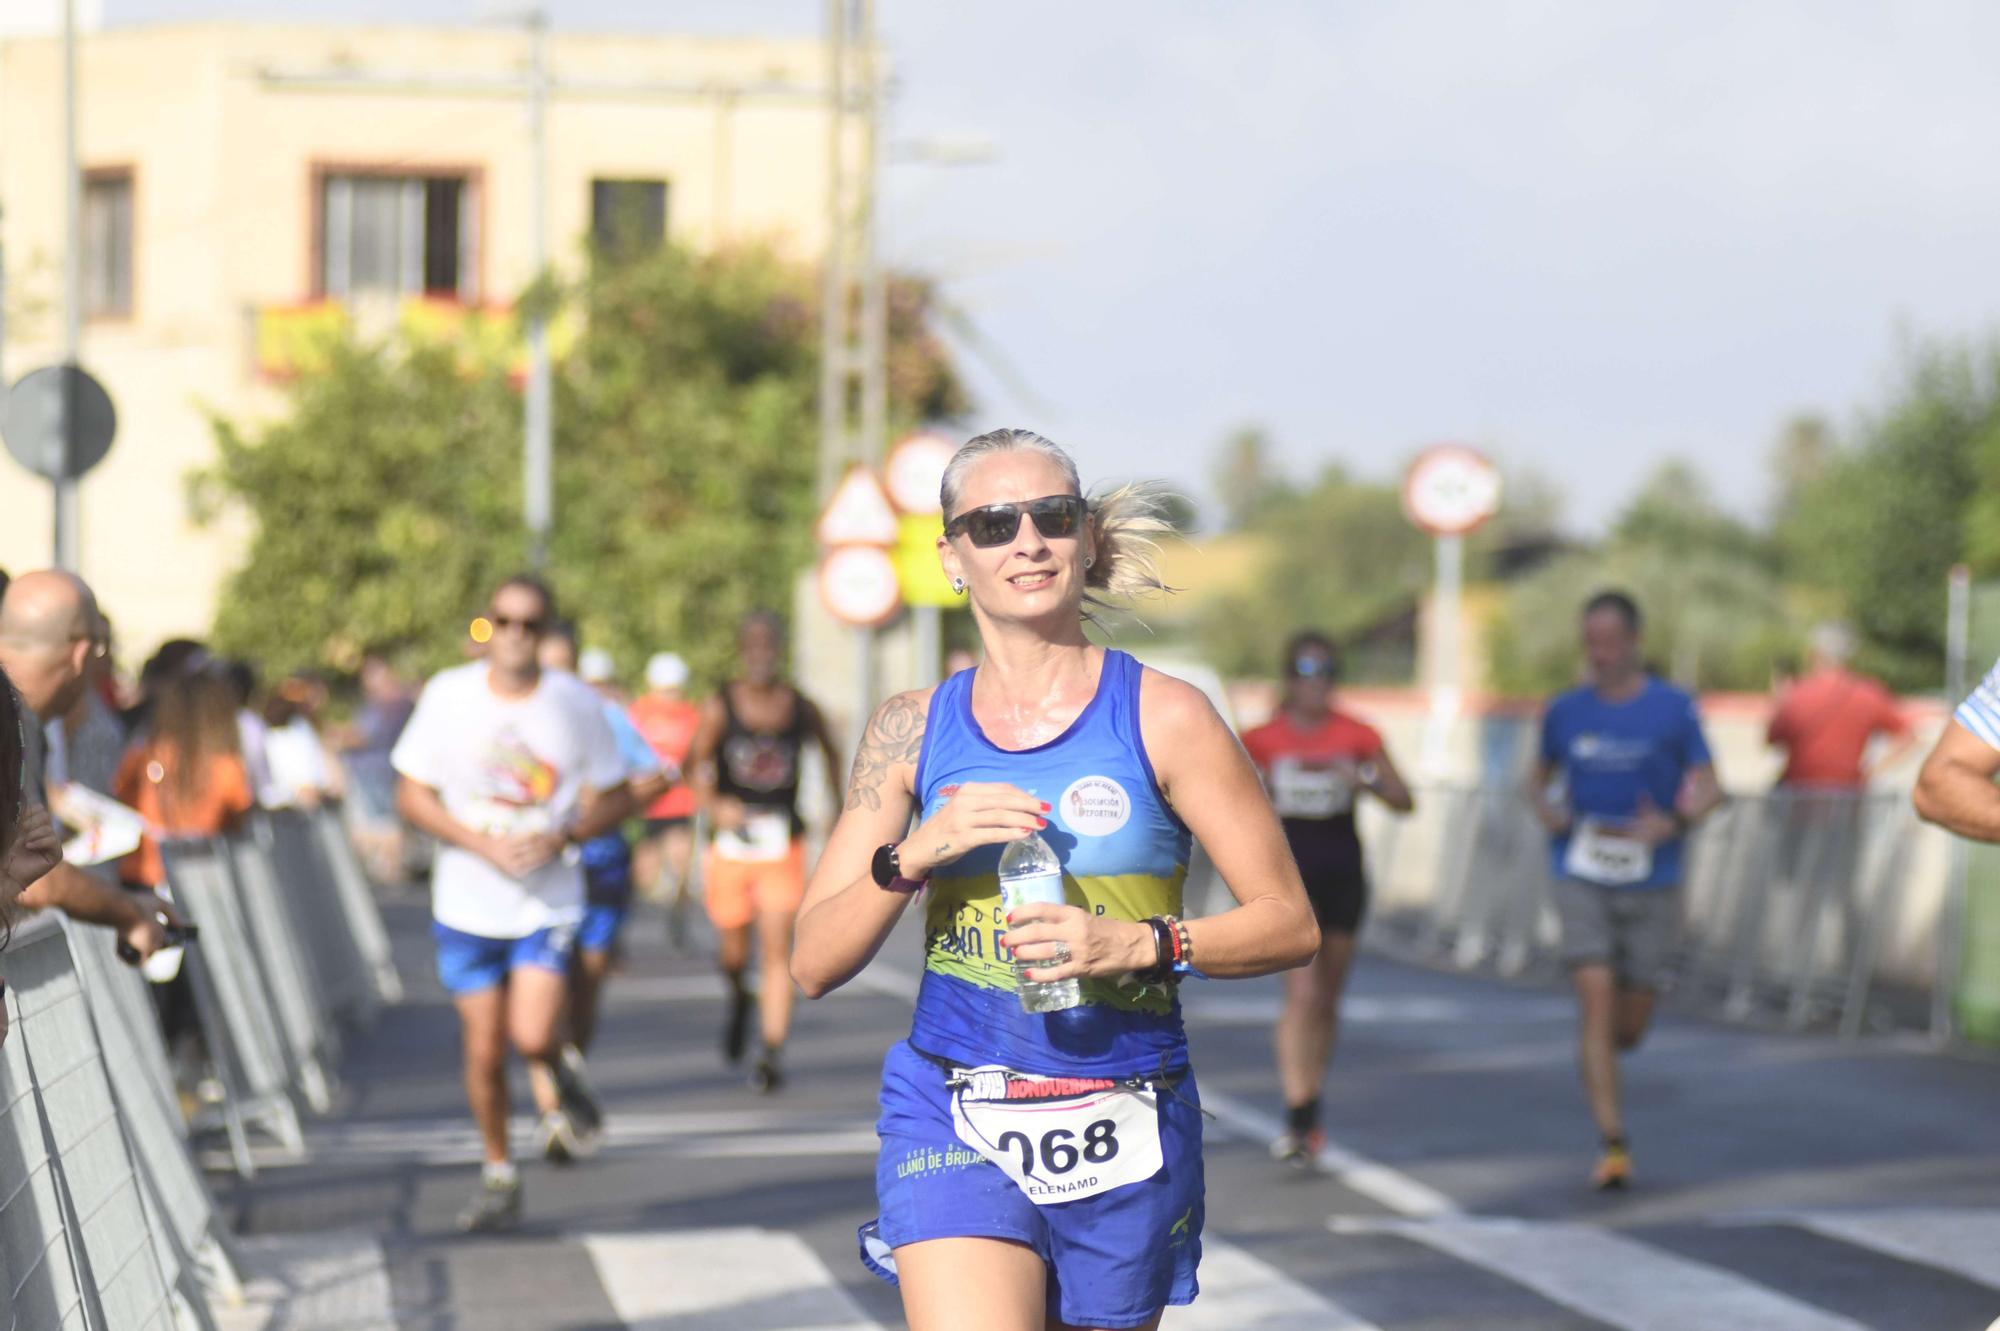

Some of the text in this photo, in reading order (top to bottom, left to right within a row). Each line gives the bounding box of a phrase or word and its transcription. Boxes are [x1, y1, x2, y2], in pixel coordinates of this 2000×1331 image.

[897, 1157, 926, 1178] LLANO
[927, 1153, 943, 1170] DE
[1029, 1176, 1098, 1195] ELENAMD
